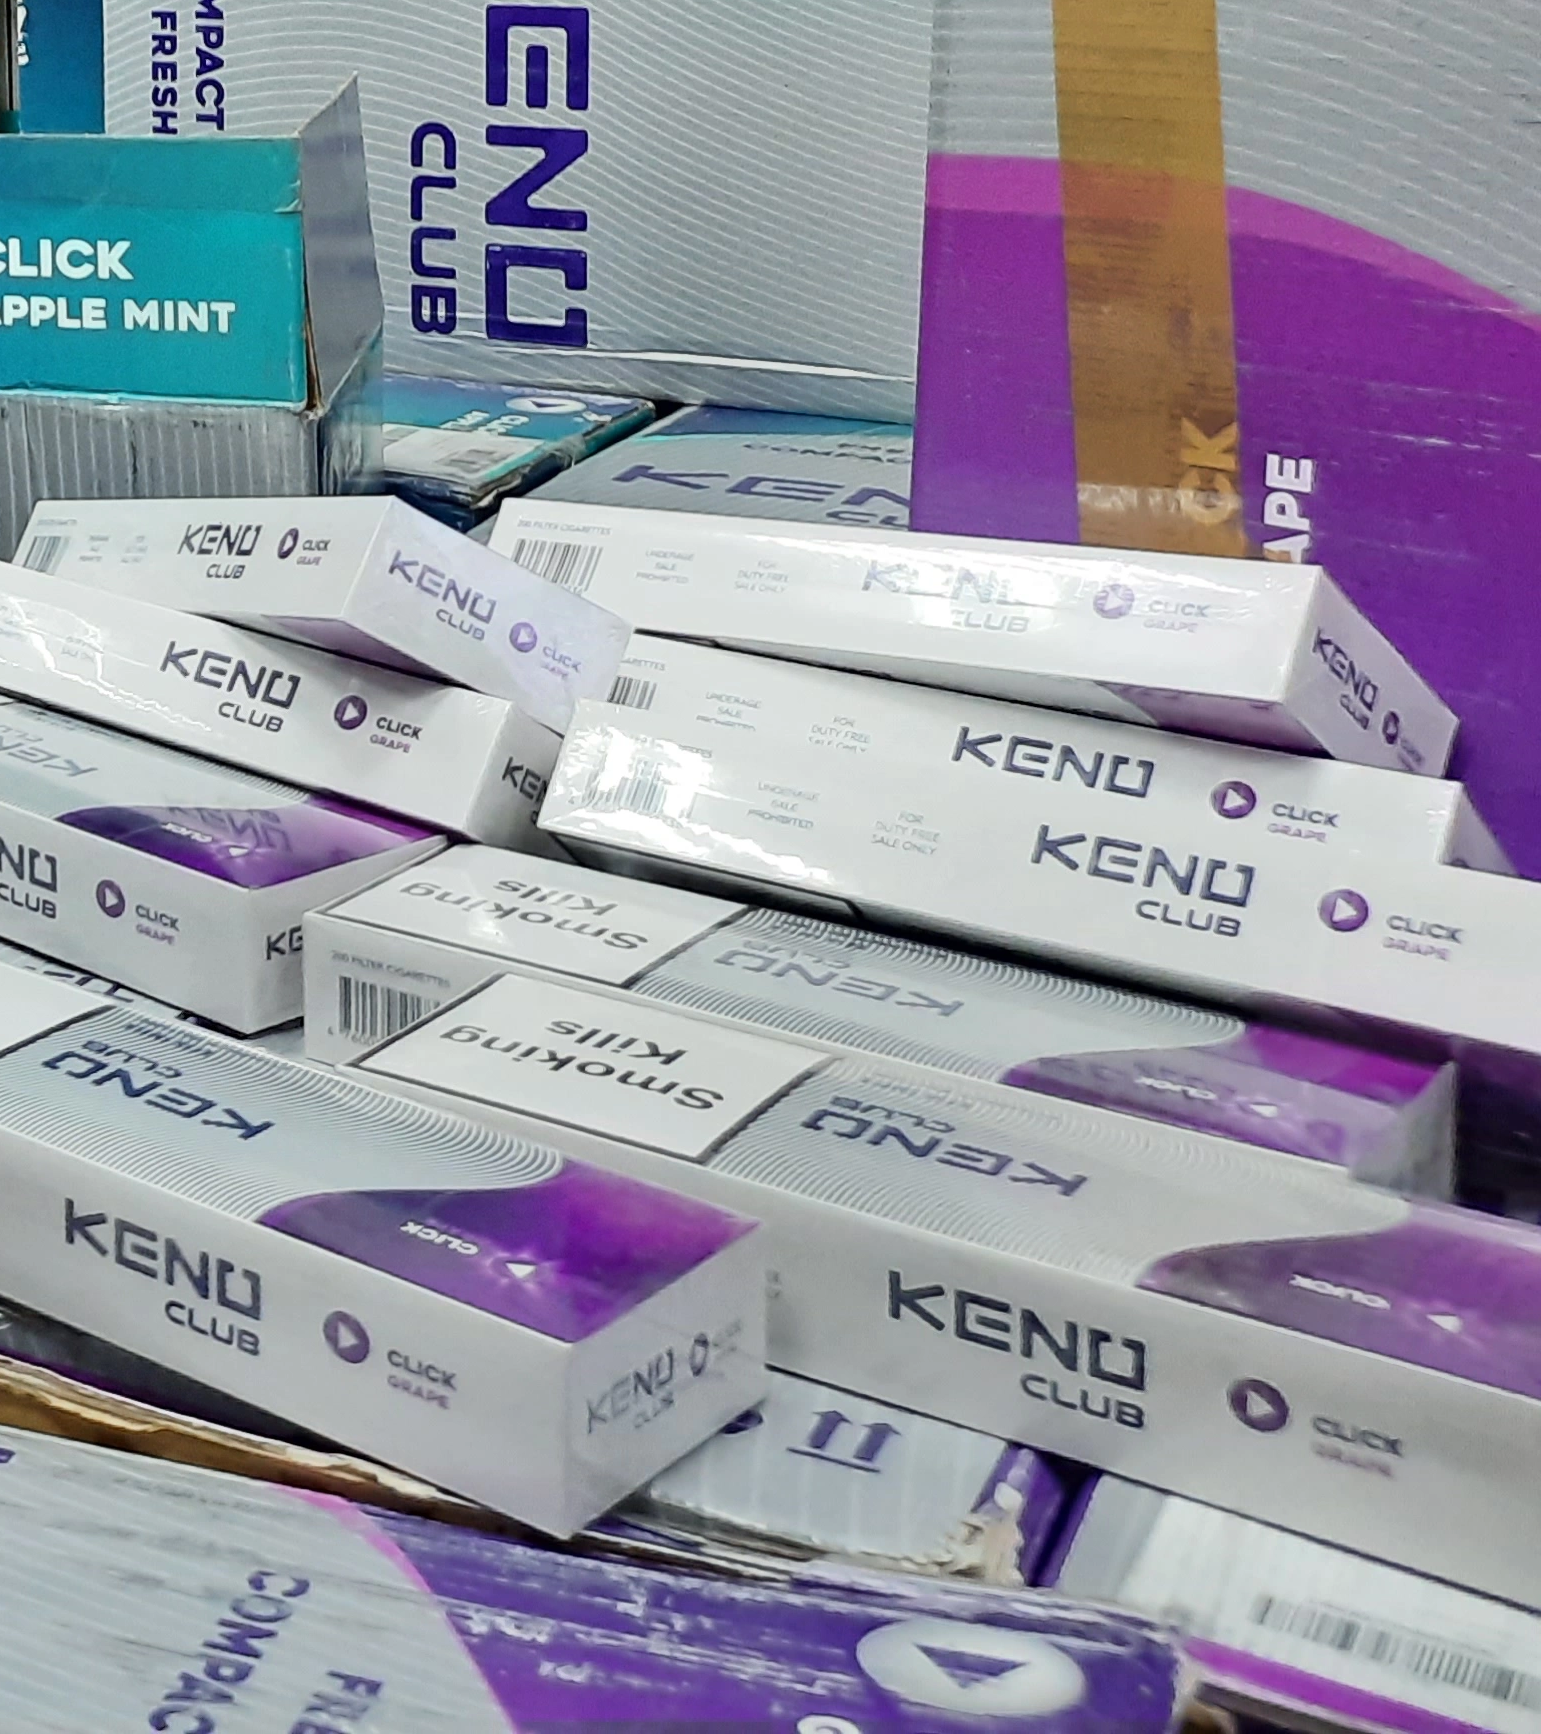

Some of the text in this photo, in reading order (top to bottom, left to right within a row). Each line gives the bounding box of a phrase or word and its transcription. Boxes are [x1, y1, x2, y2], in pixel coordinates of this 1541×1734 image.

[151, 10, 179, 135] FRESH
[410, 122, 457, 335] CLUB
[124, 298, 236, 335] MINT
[1263, 452, 1314, 564] APE
[176, 523, 263, 557] KENO
[302, 538, 331, 553] CLICK
[205, 563, 246, 580] CLUB
[387, 550, 497, 625] KENO
[435, 608, 488, 641] CLUB
[1146, 598, 1212, 618] CLICK
[159, 641, 302, 711] KENO
[542, 645, 583, 674] CLICK
[1311, 626, 1380, 713] KENO
[217, 701, 285, 734] CLUB
[375, 715, 423, 742] CLICK
[369, 733, 412, 755] GRAPE
[951, 723, 1156, 800] KENO
[1272, 801, 1340, 829] CLICK
[1031, 824, 1257, 909] KENO
[134, 902, 181, 933] CLICK
[396, 878, 649, 954] Smoking
[492, 873, 618, 918] Kills
[134, 924, 178, 948] GRAPE
[1134, 900, 1242, 939] CLUB
[1385, 915, 1464, 944] CLICK
[712, 947, 965, 1018] KENO
[80, 1037, 185, 1080] CLUB
[547, 1016, 688, 1066] Kills
[438, 1022, 726, 1116] Smoking
[38, 1051, 273, 1143] KENO
[826, 1094, 955, 1135] CLUB
[801, 1106, 1089, 1200] KENO
[63, 1197, 263, 1323] KENO
[400, 1218, 480, 1258] CLICK
[164, 1299, 263, 1358] CLUB
[887, 1270, 1149, 1393] KENO
[386, 1347, 458, 1391] CLICK
[384, 1378, 451, 1411] GRAPE
[585, 1350, 678, 1438] KENO
[1019, 1373, 1147, 1430] CLUB
[1312, 1415, 1405, 1459] CLICK
